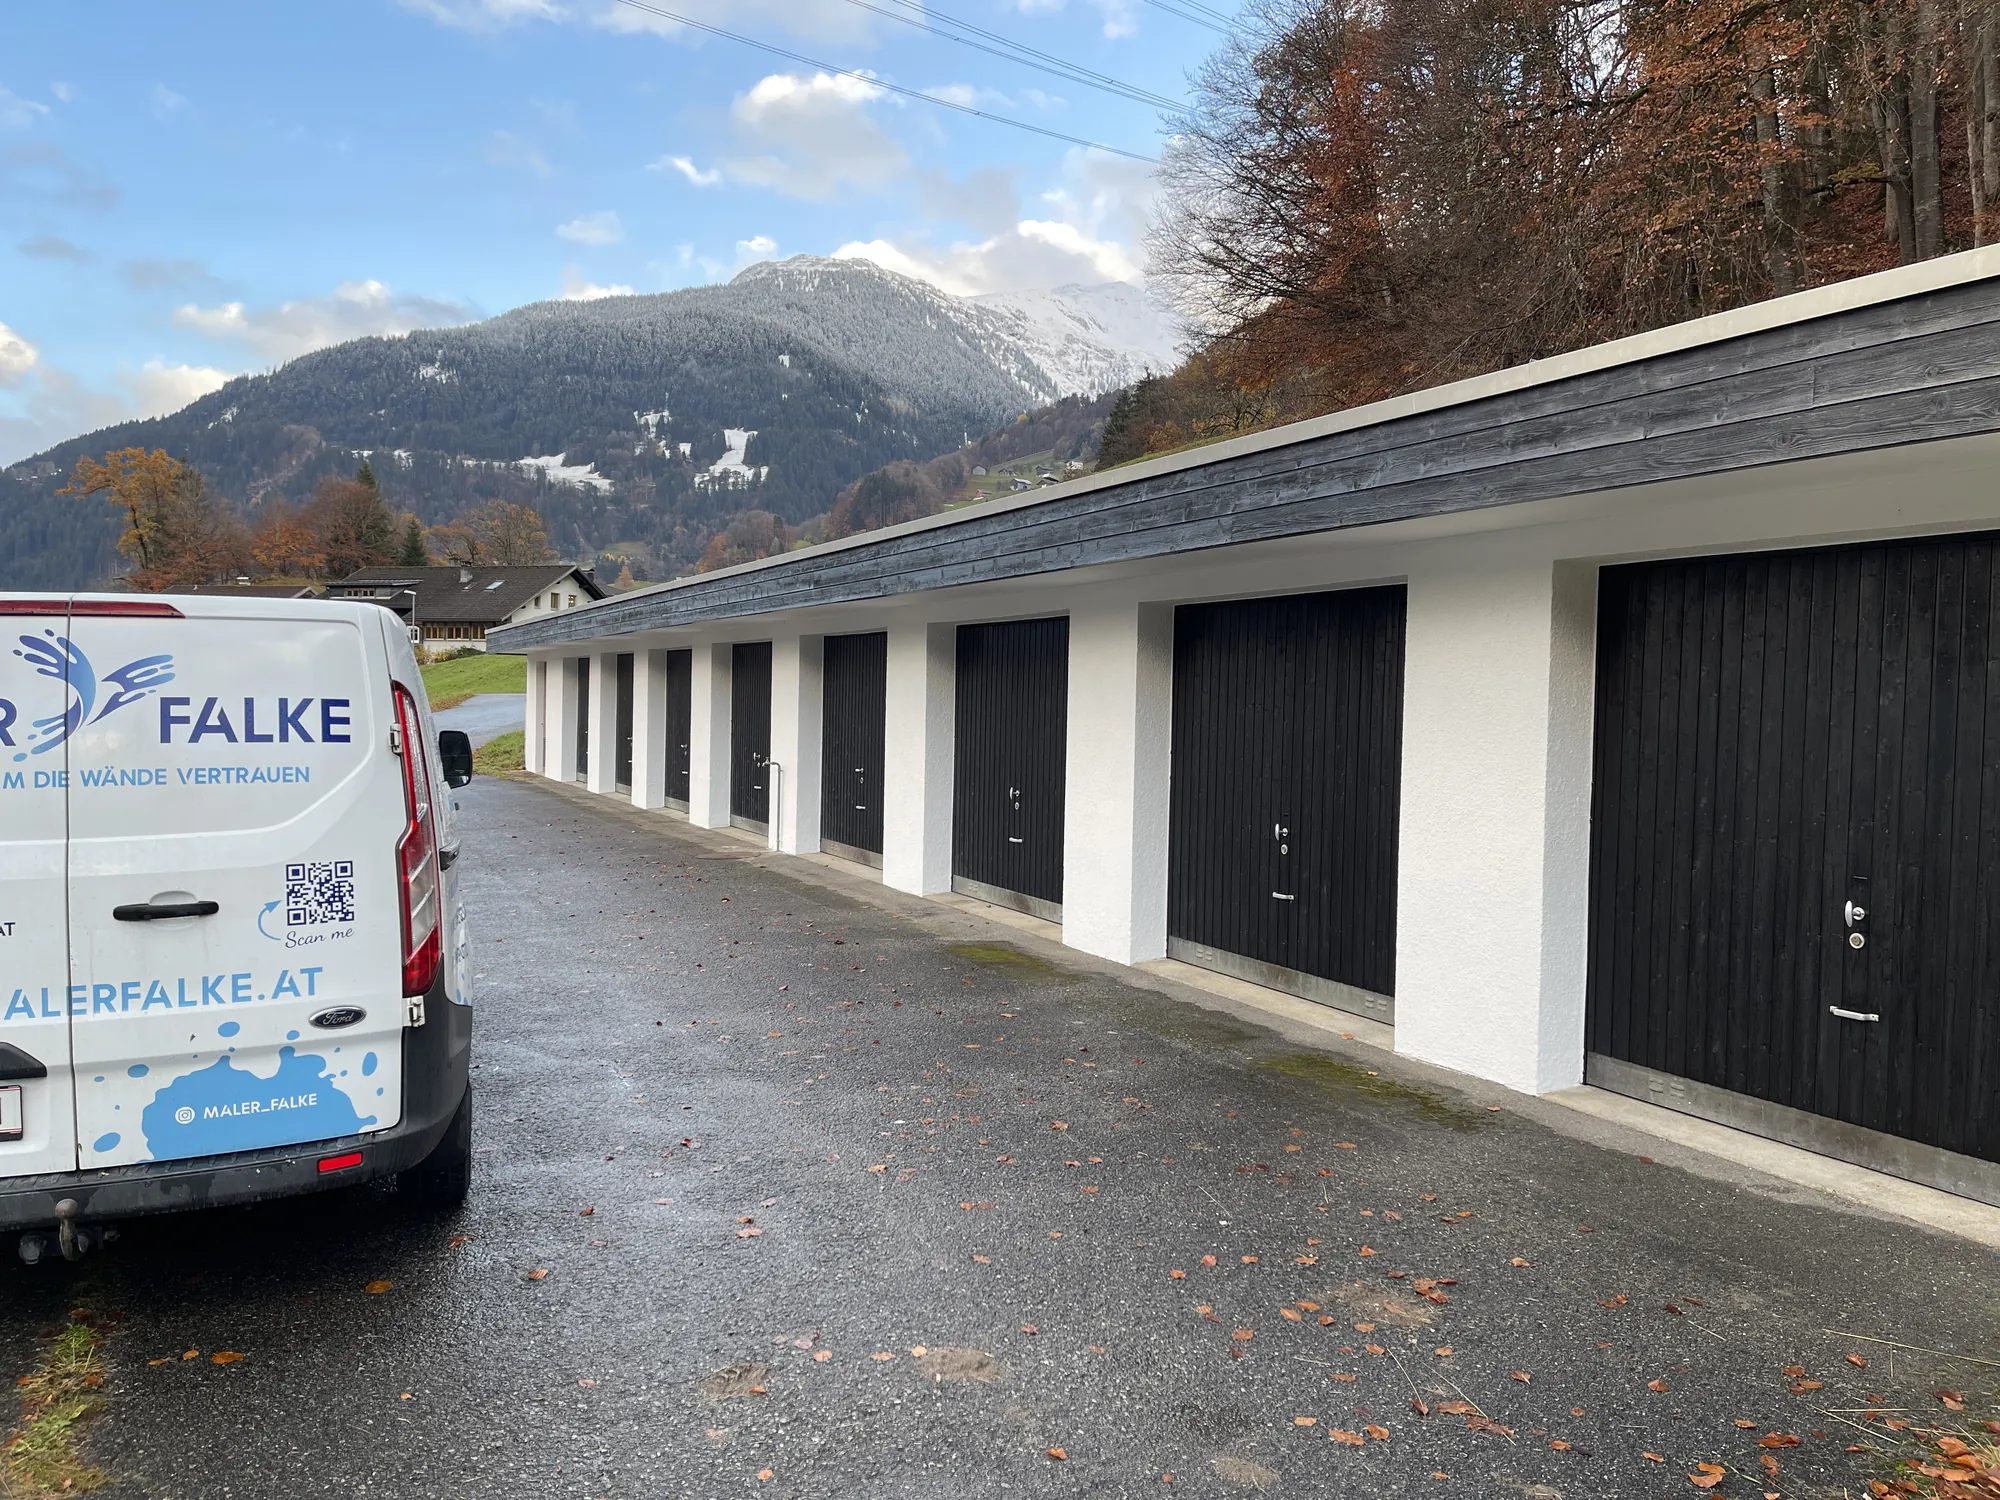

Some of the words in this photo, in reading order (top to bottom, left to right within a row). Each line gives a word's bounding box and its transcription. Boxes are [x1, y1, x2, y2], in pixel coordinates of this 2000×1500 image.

[159, 696, 352, 744] FALKE
[33, 770, 71, 789] DIE
[79, 765, 168, 788] WÄNDE
[175, 766, 311, 786] VERTRAUEN
[285, 930, 325, 949] Scan
[331, 927, 355, 941] me
[3, 966, 323, 1021] ALERFALKE.AT
[322, 1010, 355, 1025] Ford
[203, 1093, 318, 1120] MALER_FALKE
